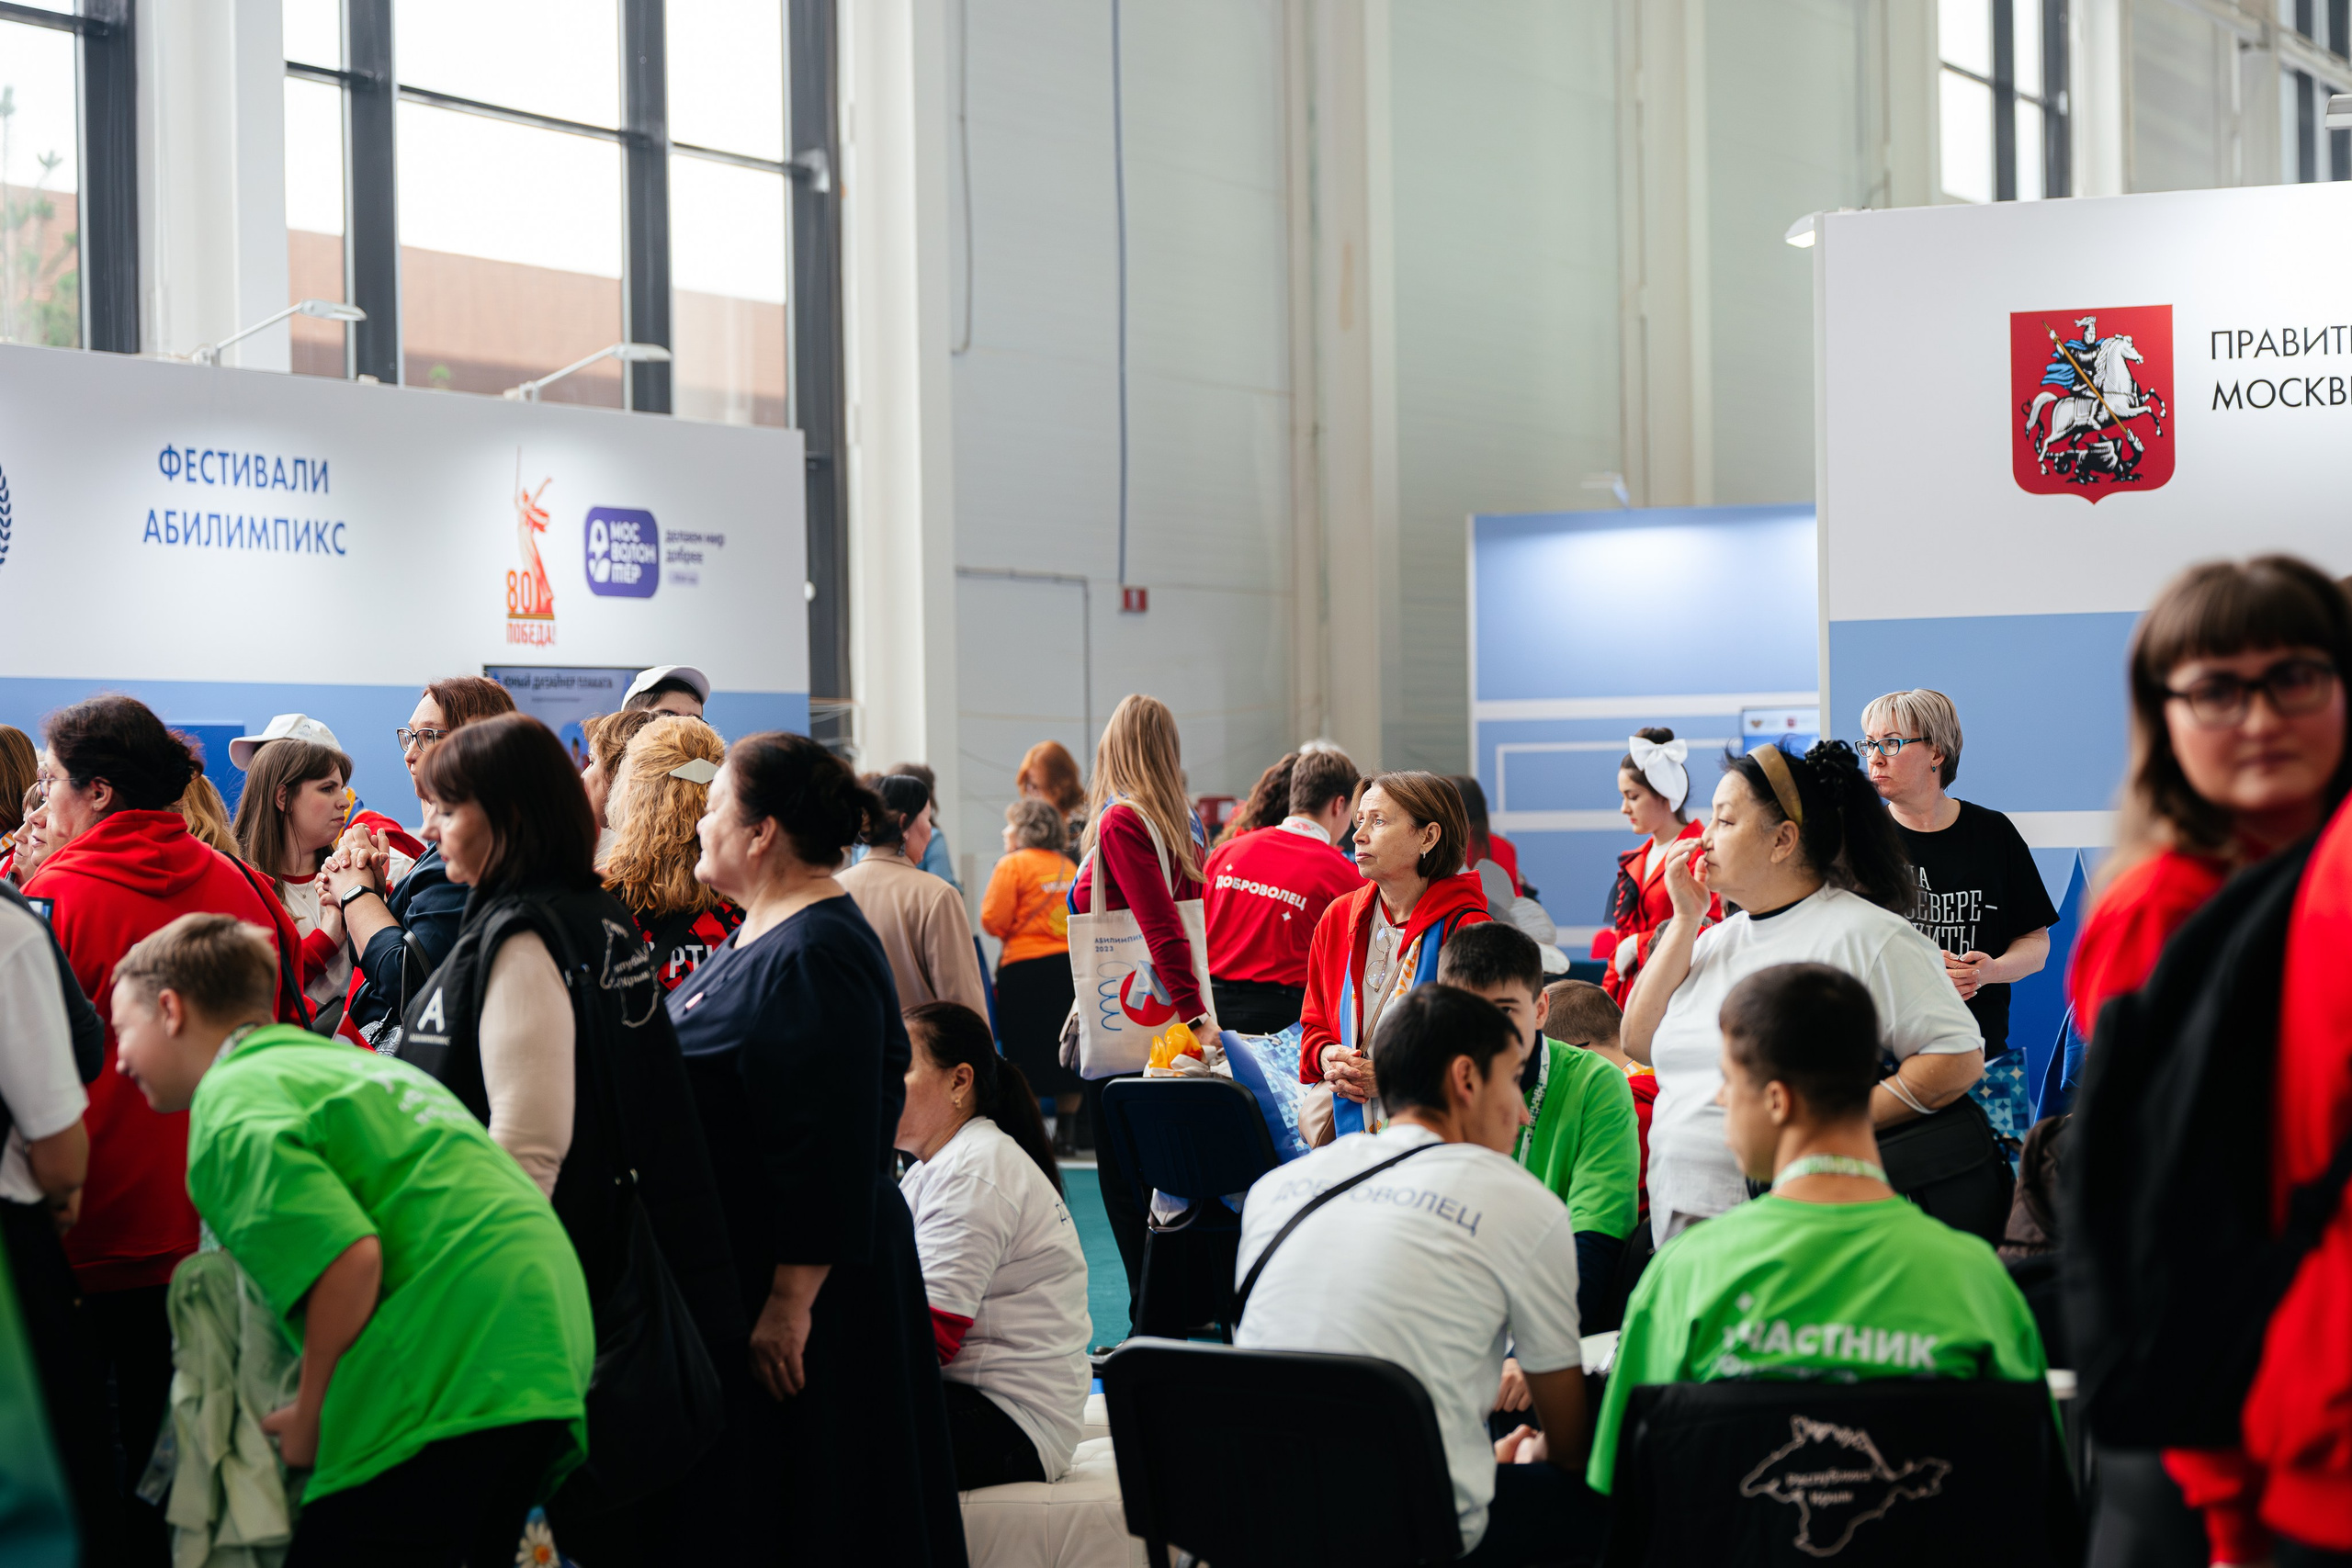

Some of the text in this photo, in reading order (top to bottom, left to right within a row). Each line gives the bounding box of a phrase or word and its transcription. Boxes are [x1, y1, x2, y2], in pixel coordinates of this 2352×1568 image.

[2211, 325, 2352, 360] ПРАВИТ
[2211, 375, 2352, 411] МОСКВ
[158, 443, 330, 494] ФЕСТИВАЛИ
[142, 508, 347, 556] АБИЛИМПИКС
[609, 520, 641, 542] МОС
[610, 541, 657, 564] ВОЛОН
[506, 570, 533, 614] 80
[506, 621, 557, 646] ПОБЕДА!
[1215, 874, 1307, 911] ДОБРОВОЛЕЦ
[1272, 1177, 1483, 1237] ДОБОВОЛЕЦ
